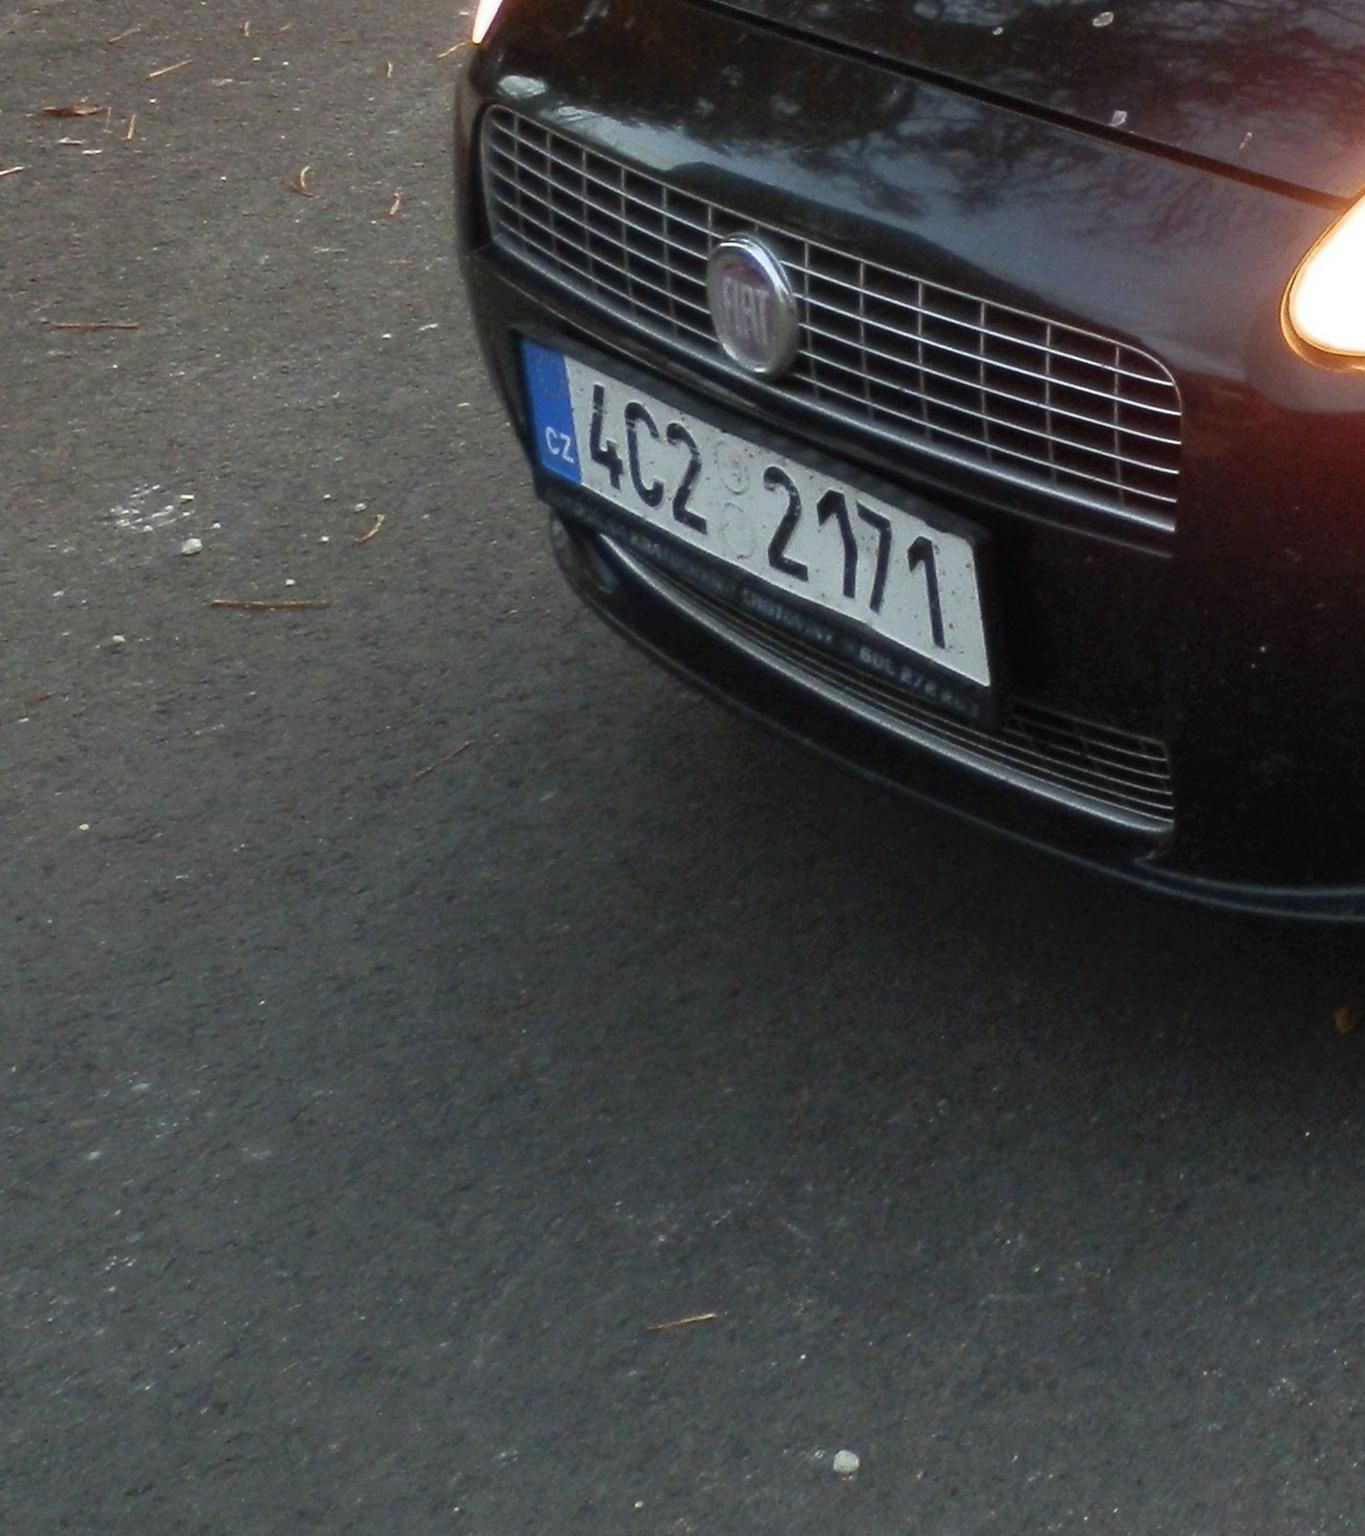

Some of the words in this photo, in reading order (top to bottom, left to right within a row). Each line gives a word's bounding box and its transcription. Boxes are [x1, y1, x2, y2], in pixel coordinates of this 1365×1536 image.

[545, 426, 575, 464] CZ
[589, 383, 708, 536] 4C2
[762, 465, 946, 650] 2171
